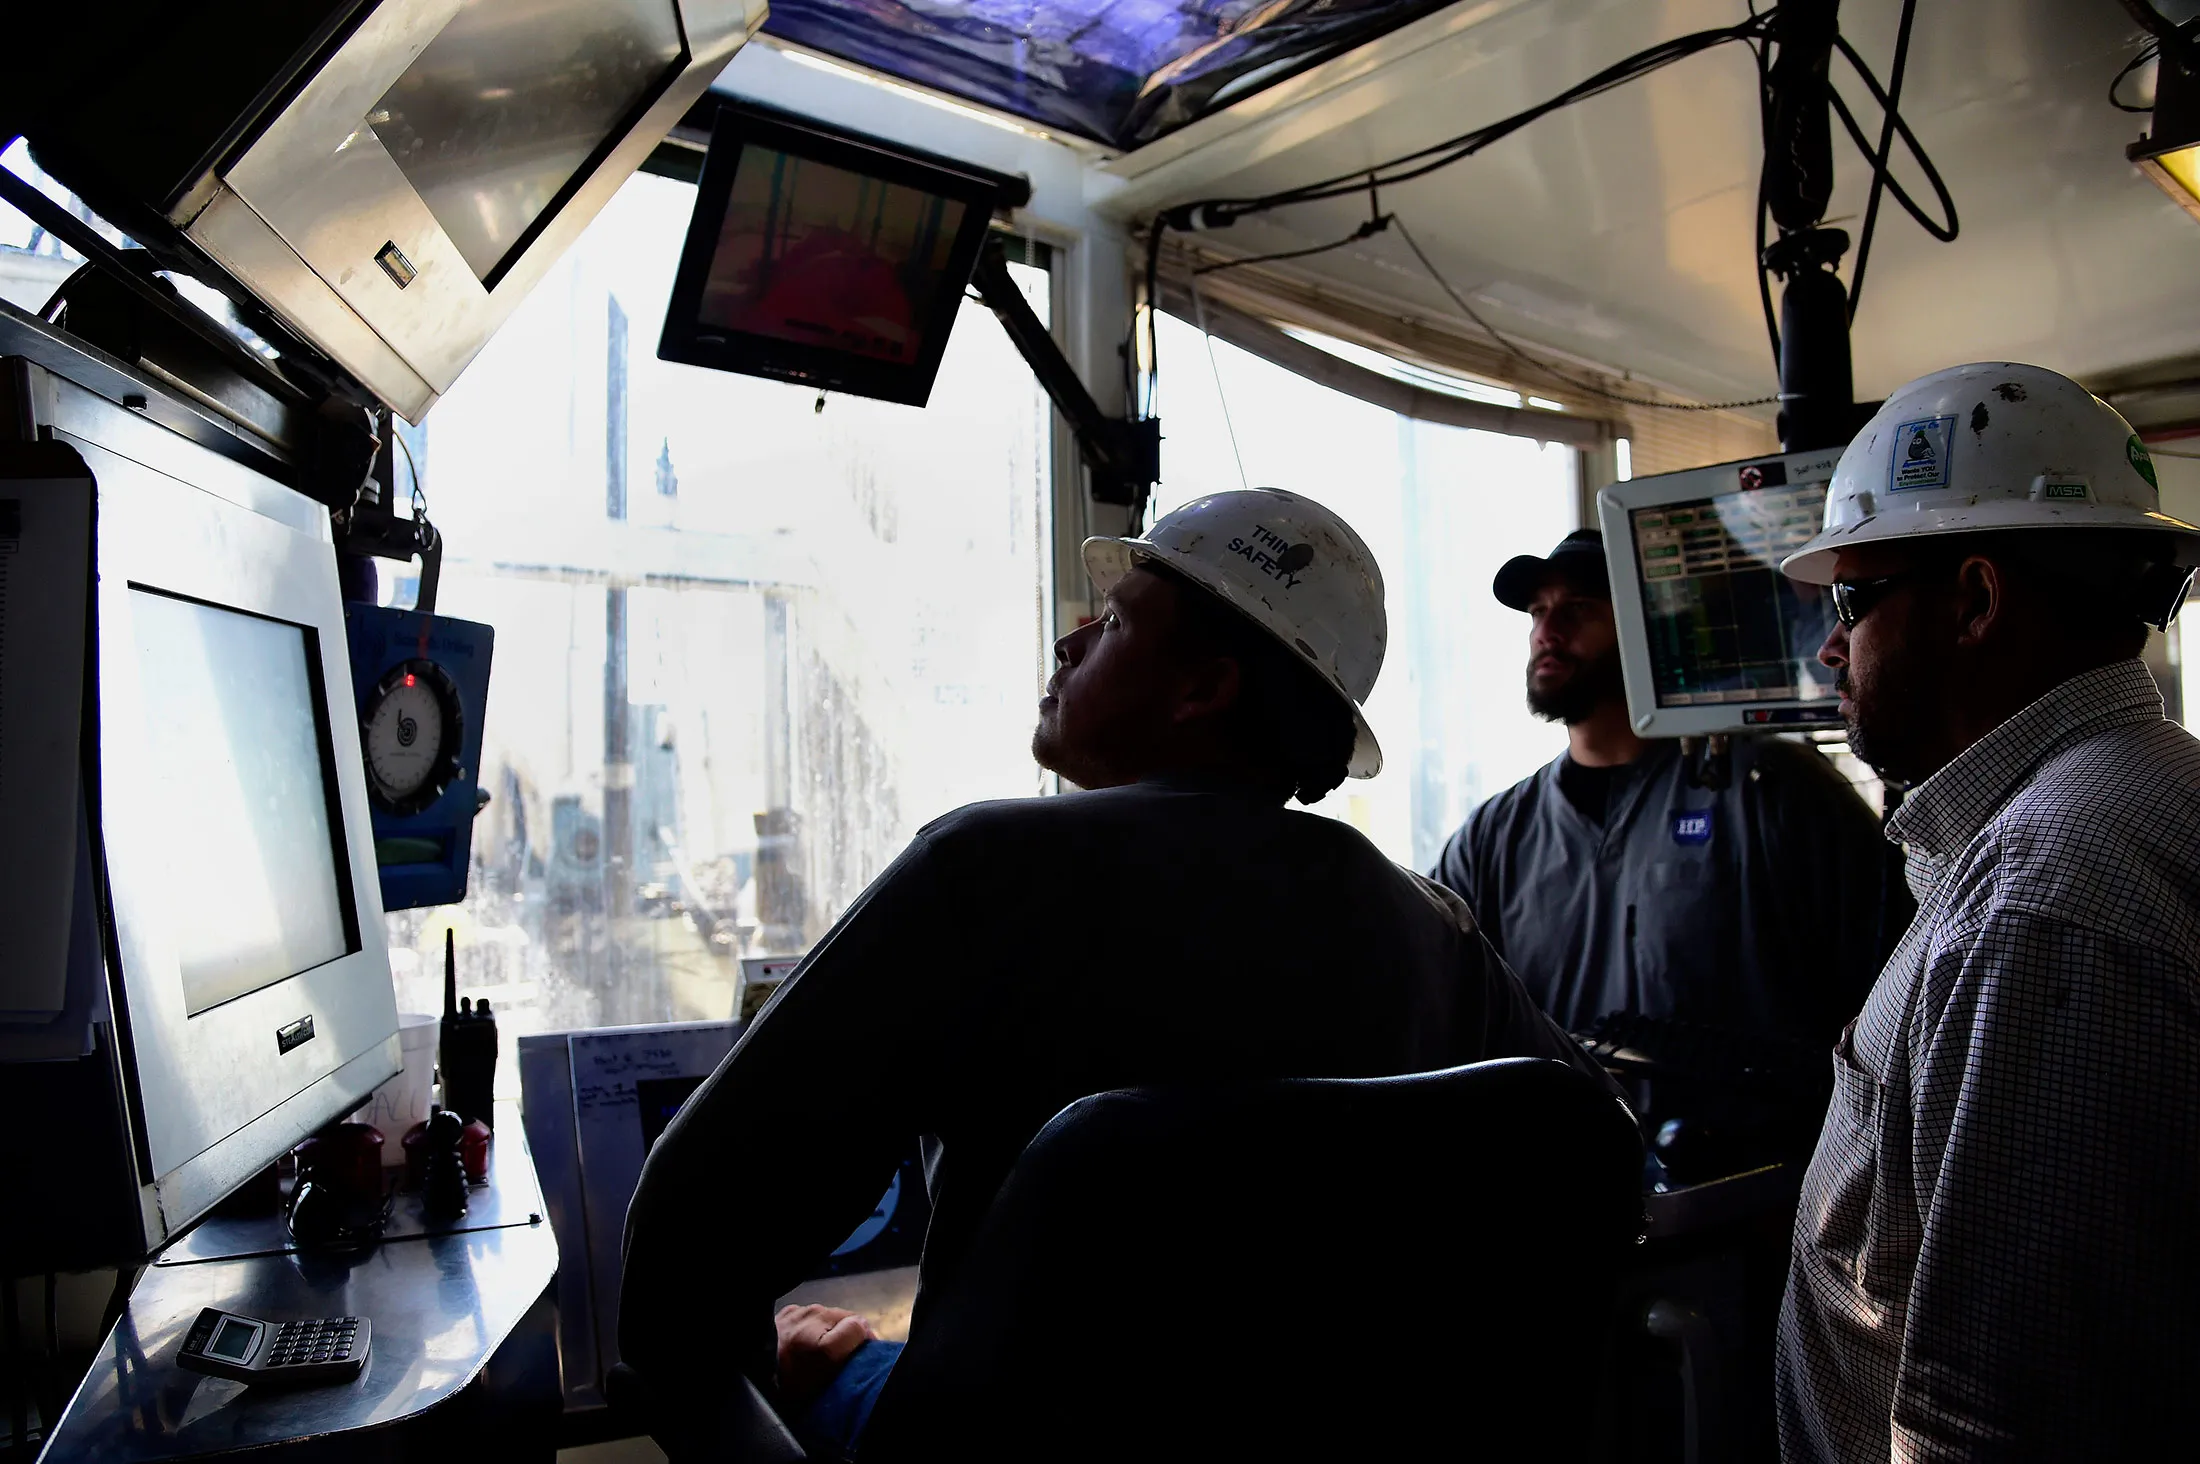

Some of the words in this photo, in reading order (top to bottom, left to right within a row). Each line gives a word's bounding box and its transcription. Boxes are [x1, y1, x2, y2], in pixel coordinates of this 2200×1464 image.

[1904, 472, 1926, 481] Protect
[2048, 486, 2085, 496] MSA
[1251, 525, 1292, 555] THIN
